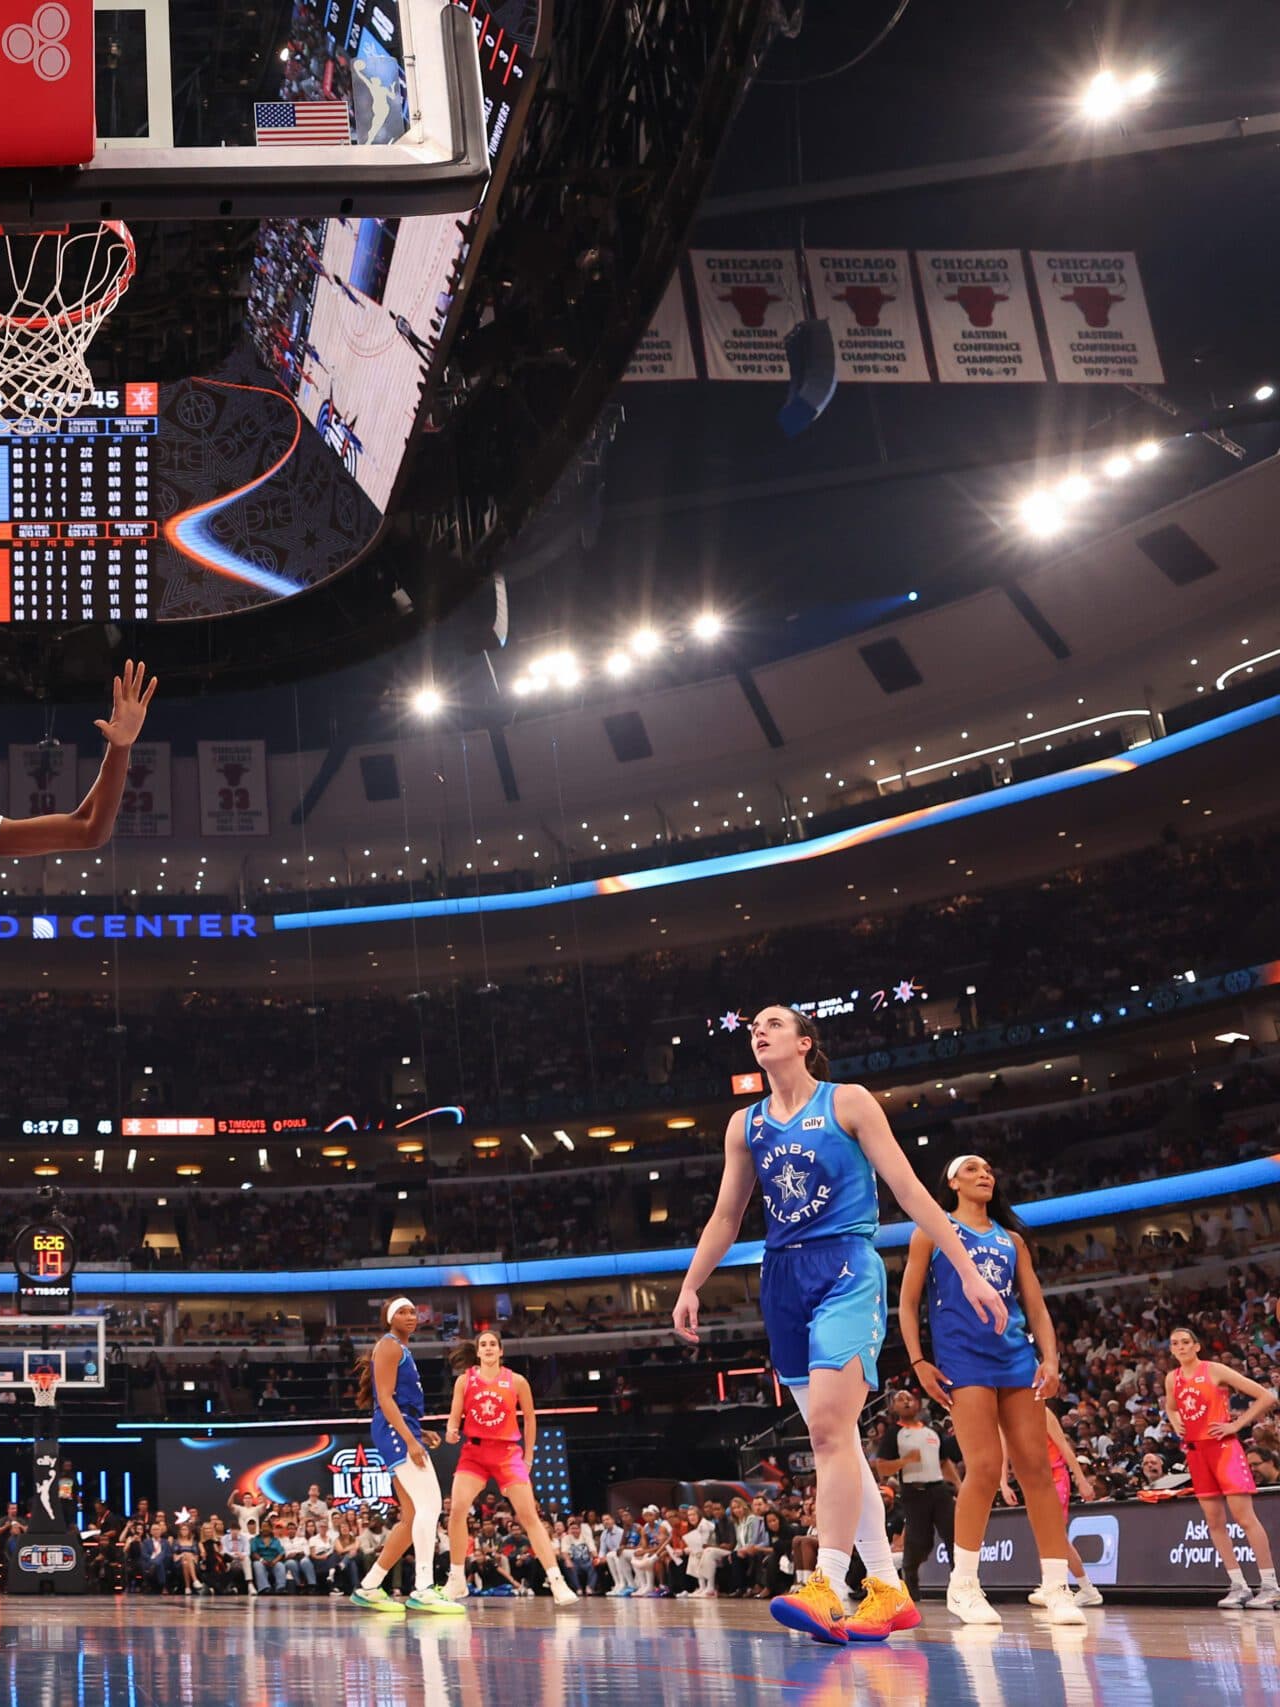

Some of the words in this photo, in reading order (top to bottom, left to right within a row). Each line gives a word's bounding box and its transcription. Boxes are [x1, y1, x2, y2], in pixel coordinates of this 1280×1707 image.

[488, 102, 510, 157] TURNOVERS
[706, 258, 783, 270] CHICAGO
[820, 257, 896, 269] CHICAGO
[931, 258, 1008, 270] CHICAGO
[1046, 258, 1124, 270] CHICAGO
[719, 272, 774, 283] BULLS
[835, 272, 890, 283] BULLS
[946, 272, 1002, 284] BULLS
[1061, 272, 1116, 284] BULLS
[733, 329, 778, 338] EASTERN
[847, 328, 892, 338] EASTERN
[962, 330, 1007, 340] EASTERN
[1078, 330, 1123, 340] EASTERN
[838, 340, 904, 350] CONFERENCE
[954, 342, 1020, 352] CONFERENCE
[1070, 342, 1137, 352] CONFERENCE
[842, 352, 906, 362] CHAMPIONS
[956, 354, 1022, 364] CHAMPIONS
[1072, 354, 1138, 364] CHAMPIONS
[91, 390, 119, 409] 45
[46, 448, 52, 458] 4
[61, 462, 67, 473] 4
[46, 478, 52, 488] 2
[46, 492, 52, 502] 4
[61, 492, 67, 502] 4
[44, 550, 54, 561] 21
[61, 580, 67, 590] 4
[61, 610, 67, 620] 2
[71, 914, 257, 939] CENTER
[817, 1002, 854, 1018] STAR
[22, 1120, 59, 1134] 6:27
[218, 1121, 226, 1132] 5
[229, 1120, 266, 1128] TIMEOUTS
[273, 1120, 282, 1131] 0
[283, 1118, 306, 1128] FOULS
[804, 1118, 822, 1129] ally
[762, 1143, 816, 1170] WNBA
[763, 1185, 832, 1224] ALL-STAR
[34, 1236, 64, 1250] 6:26
[39, 1251, 62, 1276] 19
[34, 1288, 70, 1296] TISSOT
[474, 1390, 503, 1403] WNBA
[471, 1408, 506, 1427] ALL-STAR
[36, 1456, 57, 1468] ally
[333, 1472, 356, 1498] ALL
[362, 1472, 393, 1498] STAR
[1185, 1520, 1209, 1540] Ask
[1226, 1523, 1246, 1539] ore
[980, 1540, 999, 1562] ixel
[1000, 1540, 1013, 1562] 10
[1170, 1543, 1184, 1564] of
[1185, 1547, 1214, 1569] your
[1215, 1546, 1257, 1568] pone
